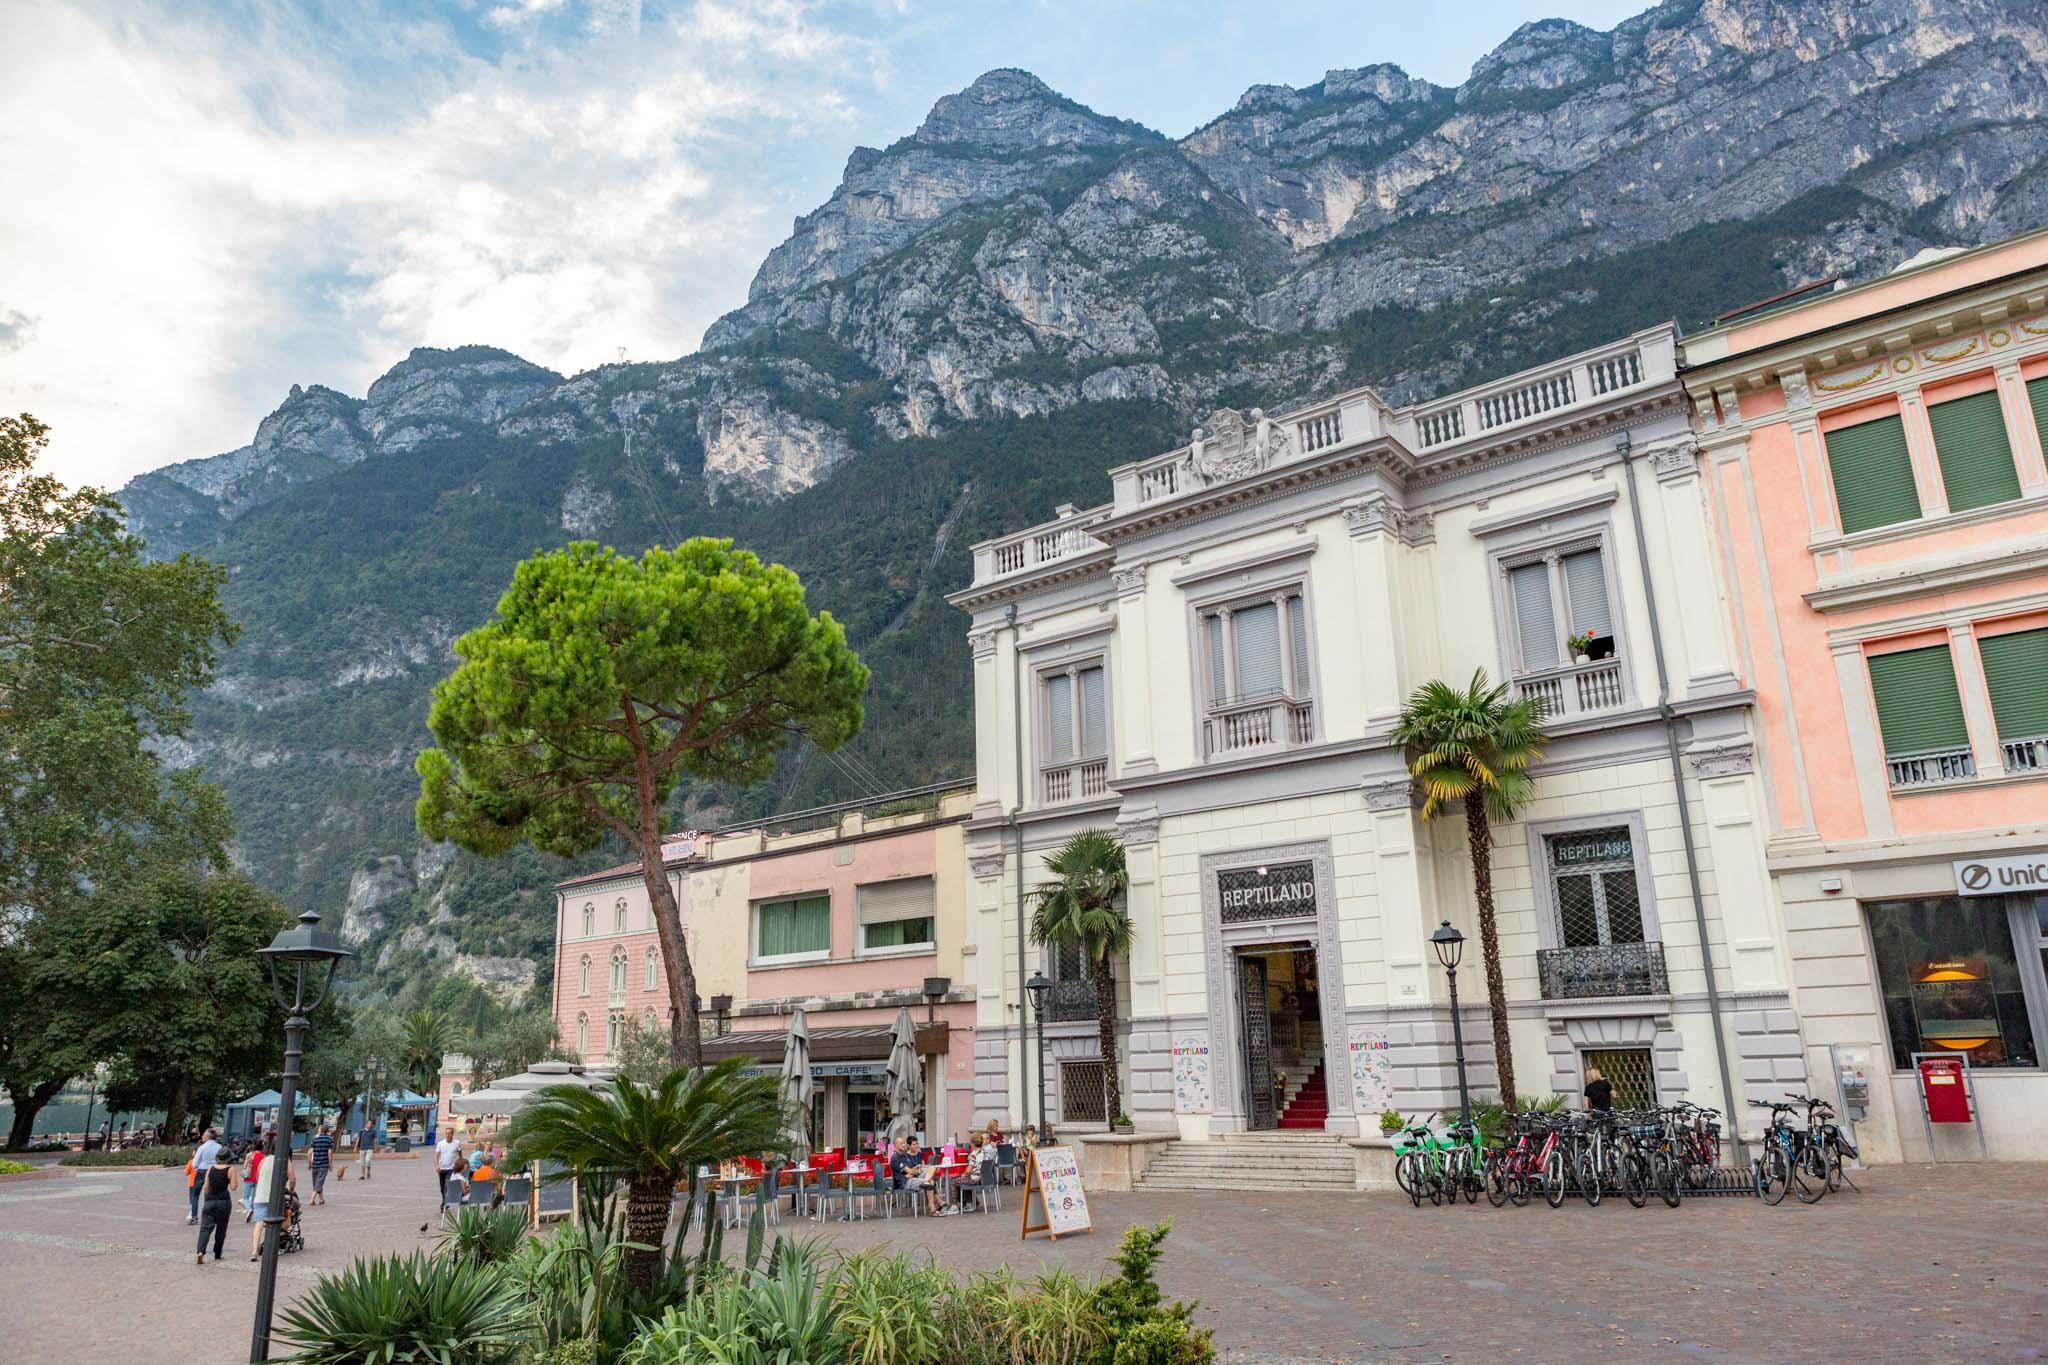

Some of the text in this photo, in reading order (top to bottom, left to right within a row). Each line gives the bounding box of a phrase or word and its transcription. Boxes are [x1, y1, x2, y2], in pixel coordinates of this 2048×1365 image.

[1558, 841, 1631, 861] REPTILAND
[1998, 863, 2048, 887] UniC
[1222, 881, 1314, 908] REPTILAND
[1173, 1047, 1209, 1056] REPTILAND
[1351, 1041, 1389, 1051] REPTILAND
[1041, 1167, 1077, 1180] REPTILAND
